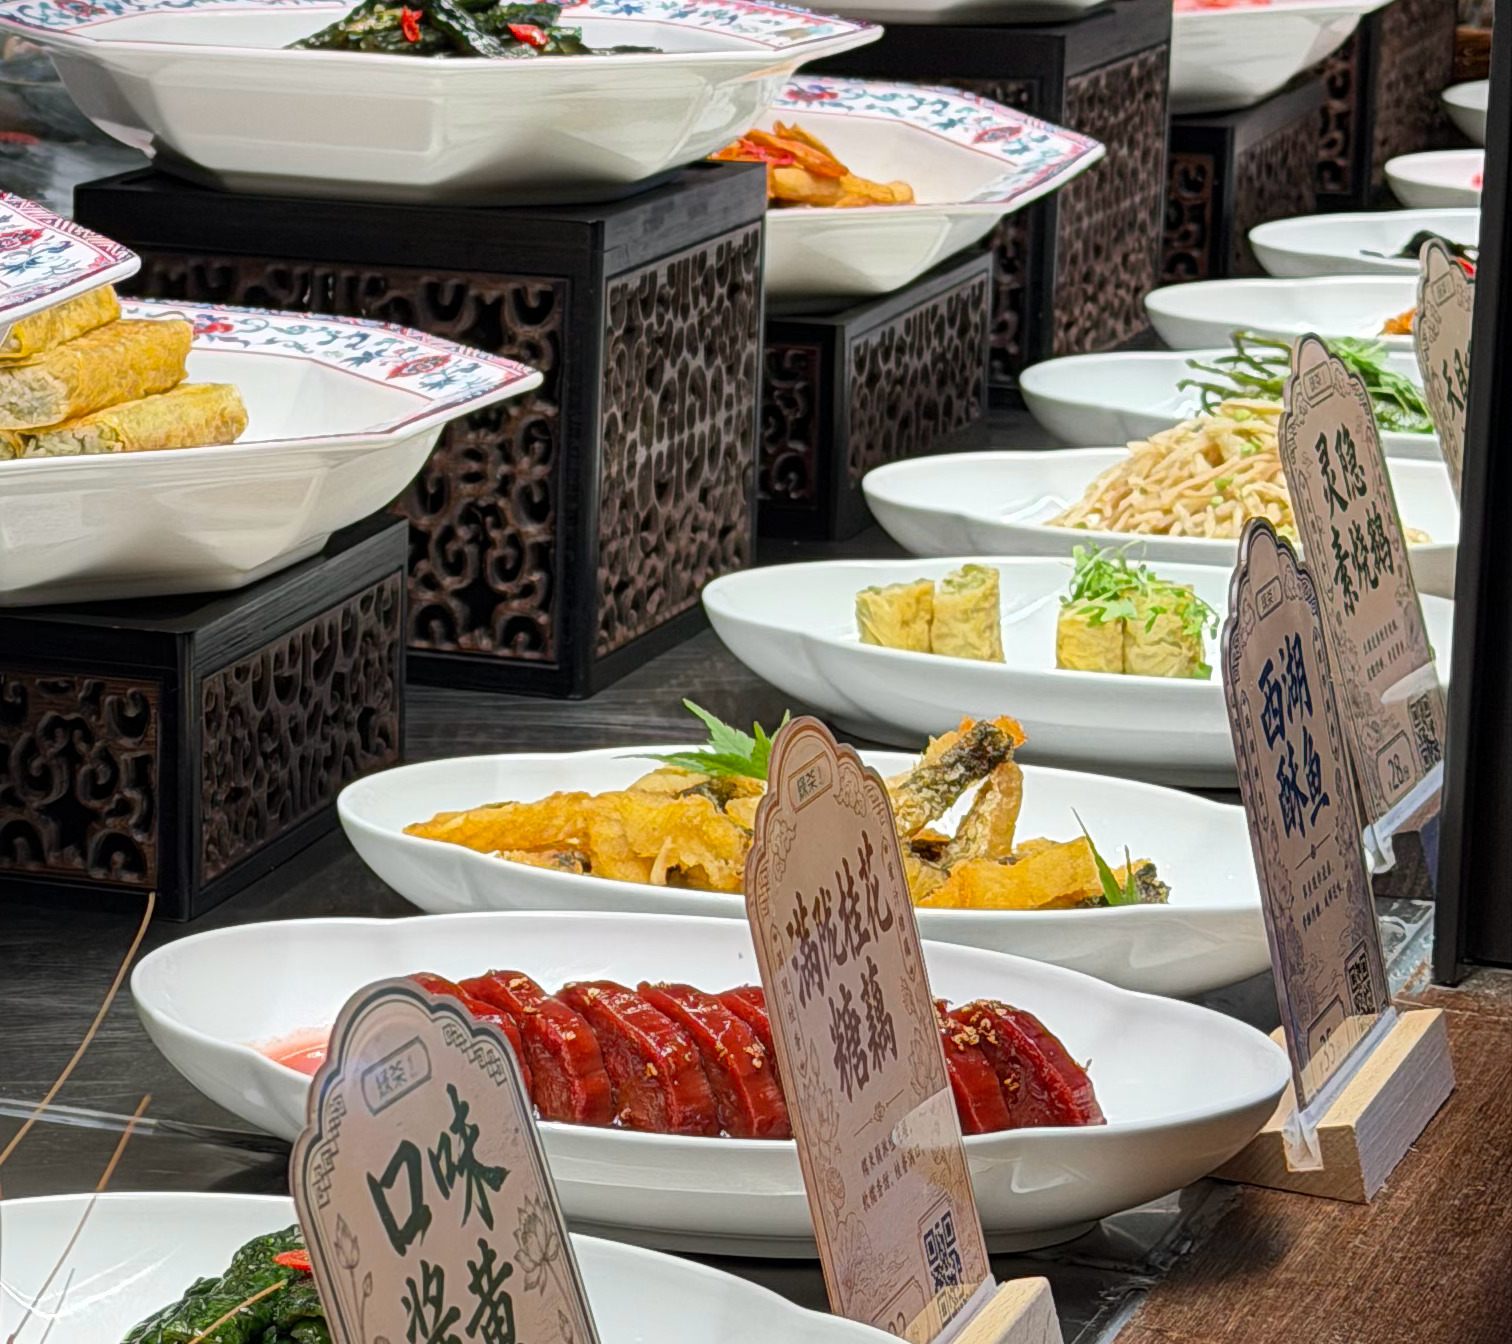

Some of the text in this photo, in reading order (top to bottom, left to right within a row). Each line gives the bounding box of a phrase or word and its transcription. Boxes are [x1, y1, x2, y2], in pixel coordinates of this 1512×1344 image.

[1315, 422, 1367, 520] 灵隐
[1331, 501, 1395, 617] 素烧鹅
[1258, 632, 1313, 751] 西湖
[1276, 725, 1330, 839] 酥鱼
[786, 830, 894, 1009] 满陇桂花
[829, 955, 898, 1103] 糖藕
[367, 1082, 511, 1257] 口味
